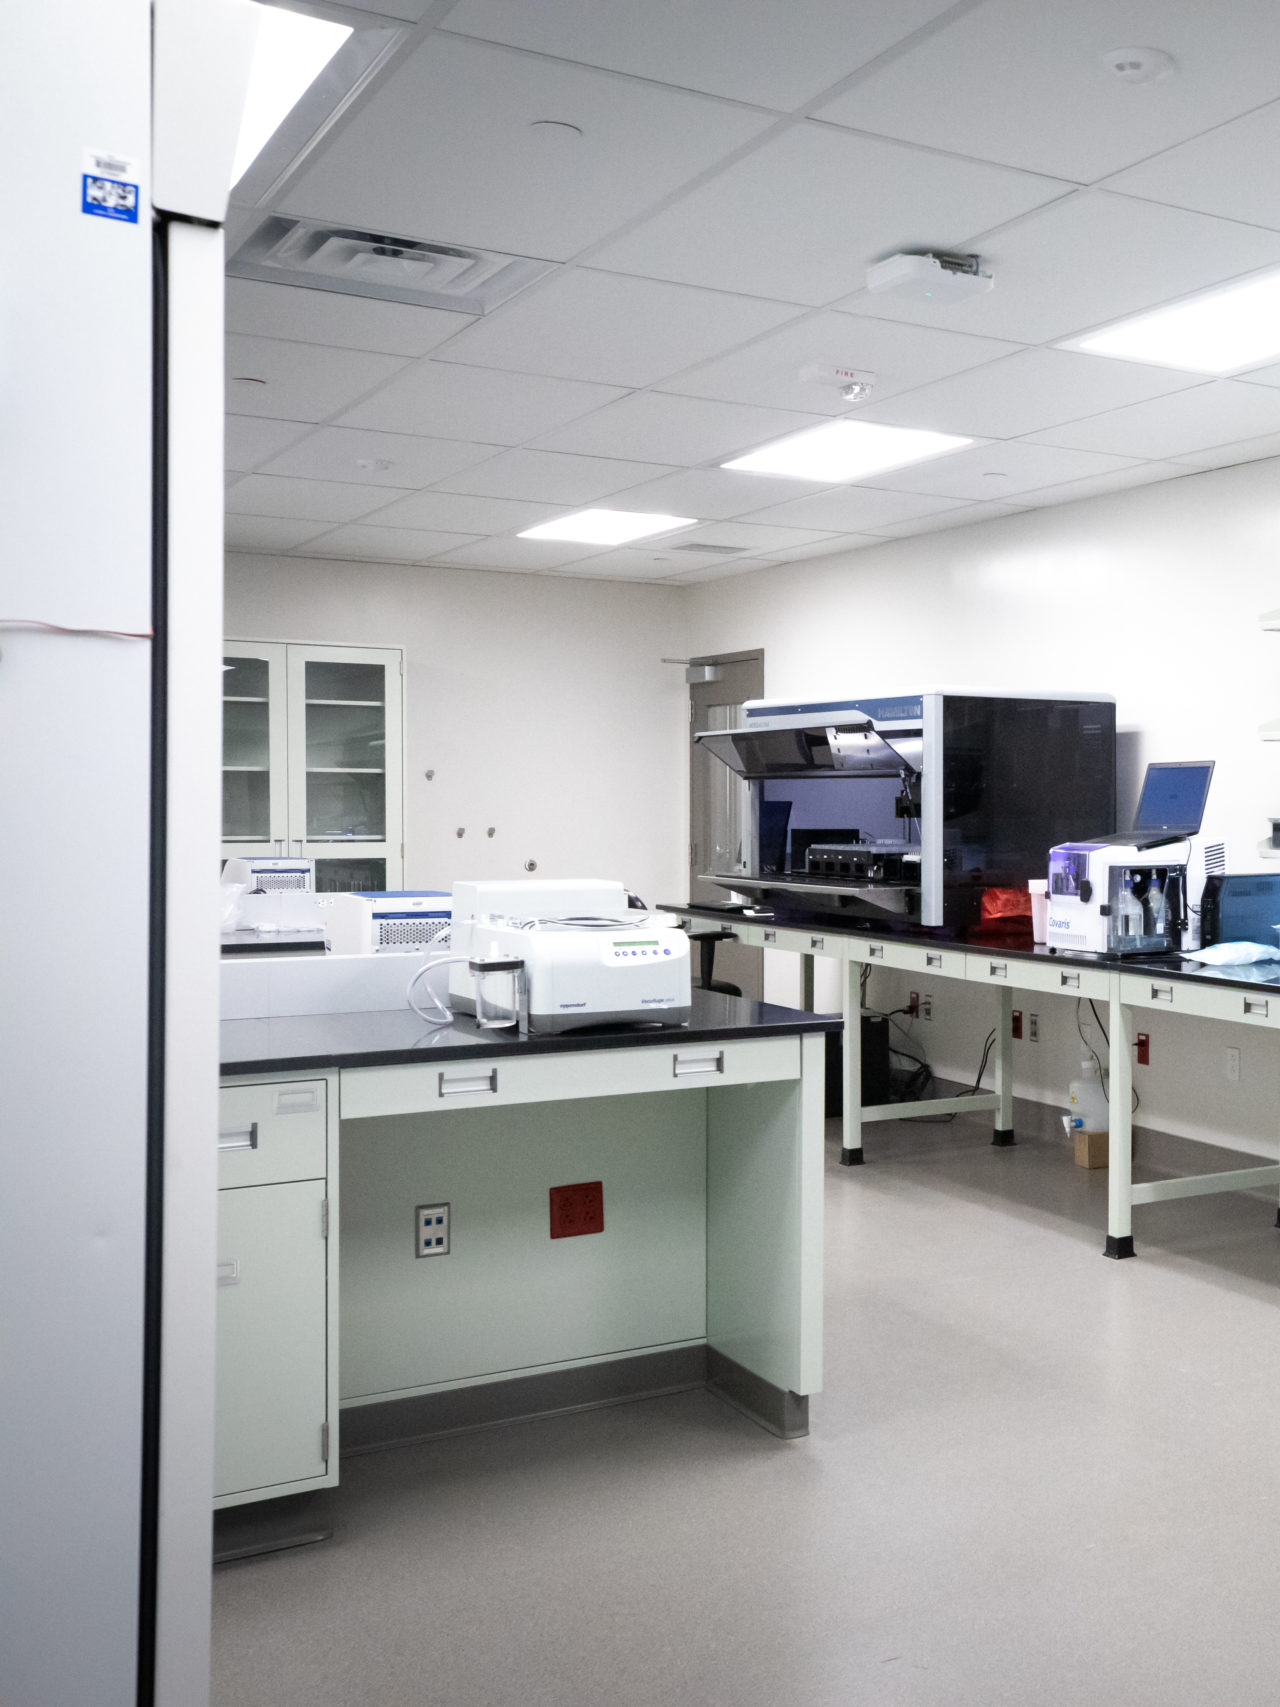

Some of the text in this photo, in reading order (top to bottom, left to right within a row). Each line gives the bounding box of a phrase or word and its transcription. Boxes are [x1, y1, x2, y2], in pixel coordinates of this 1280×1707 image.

[836, 369, 855, 378] FIRE
[878, 705, 921, 718] HAMILTON
[1049, 917, 1070, 929] Covaris
